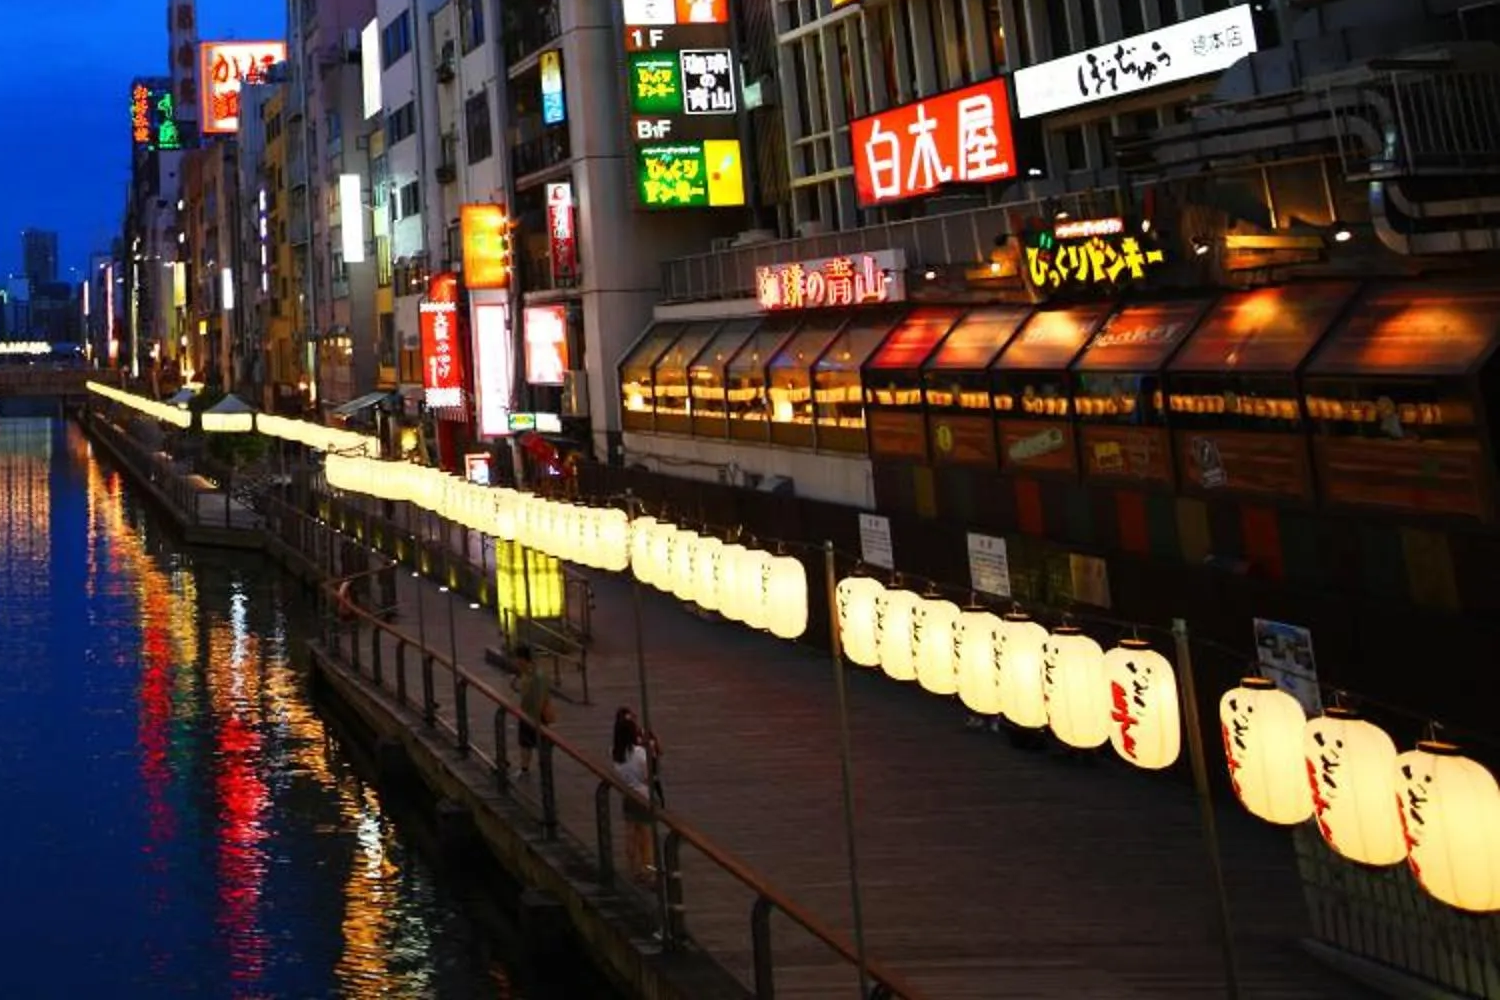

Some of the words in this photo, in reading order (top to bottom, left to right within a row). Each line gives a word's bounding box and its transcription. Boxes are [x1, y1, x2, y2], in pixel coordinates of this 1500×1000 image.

[632, 29, 663, 48] 1F
[865, 93, 1009, 199] 白木屋
